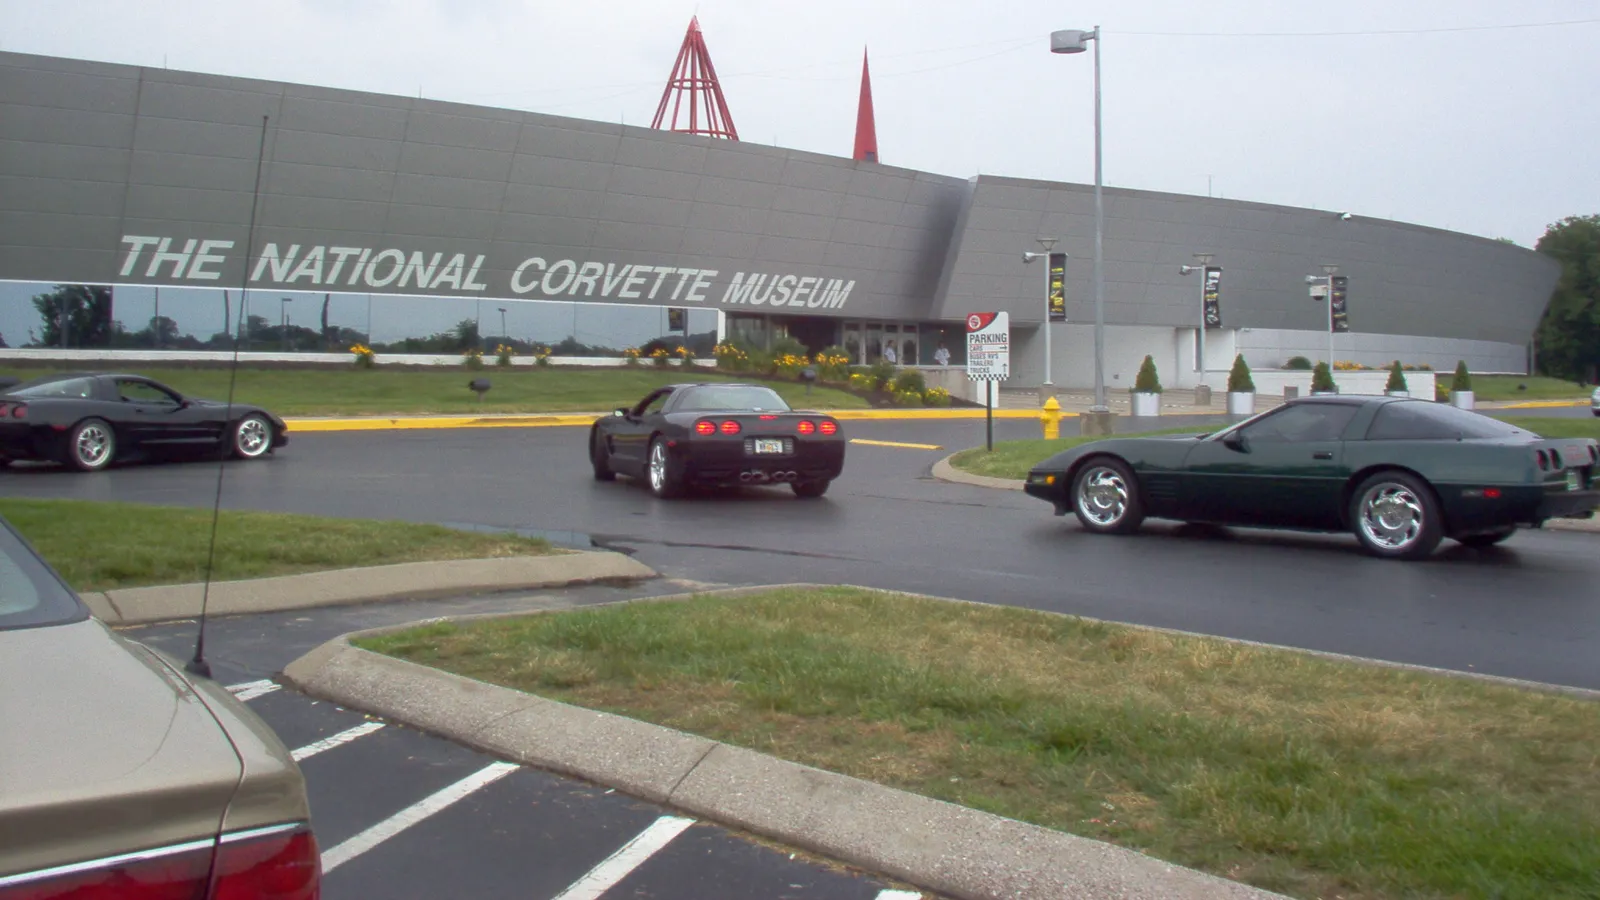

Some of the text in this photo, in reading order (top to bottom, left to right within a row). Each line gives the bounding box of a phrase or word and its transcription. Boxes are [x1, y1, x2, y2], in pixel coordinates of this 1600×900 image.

[119, 235, 856, 309] THE NATIONAL CORVETTE MUSEUM
[969, 333, 1007, 343] PARKING
